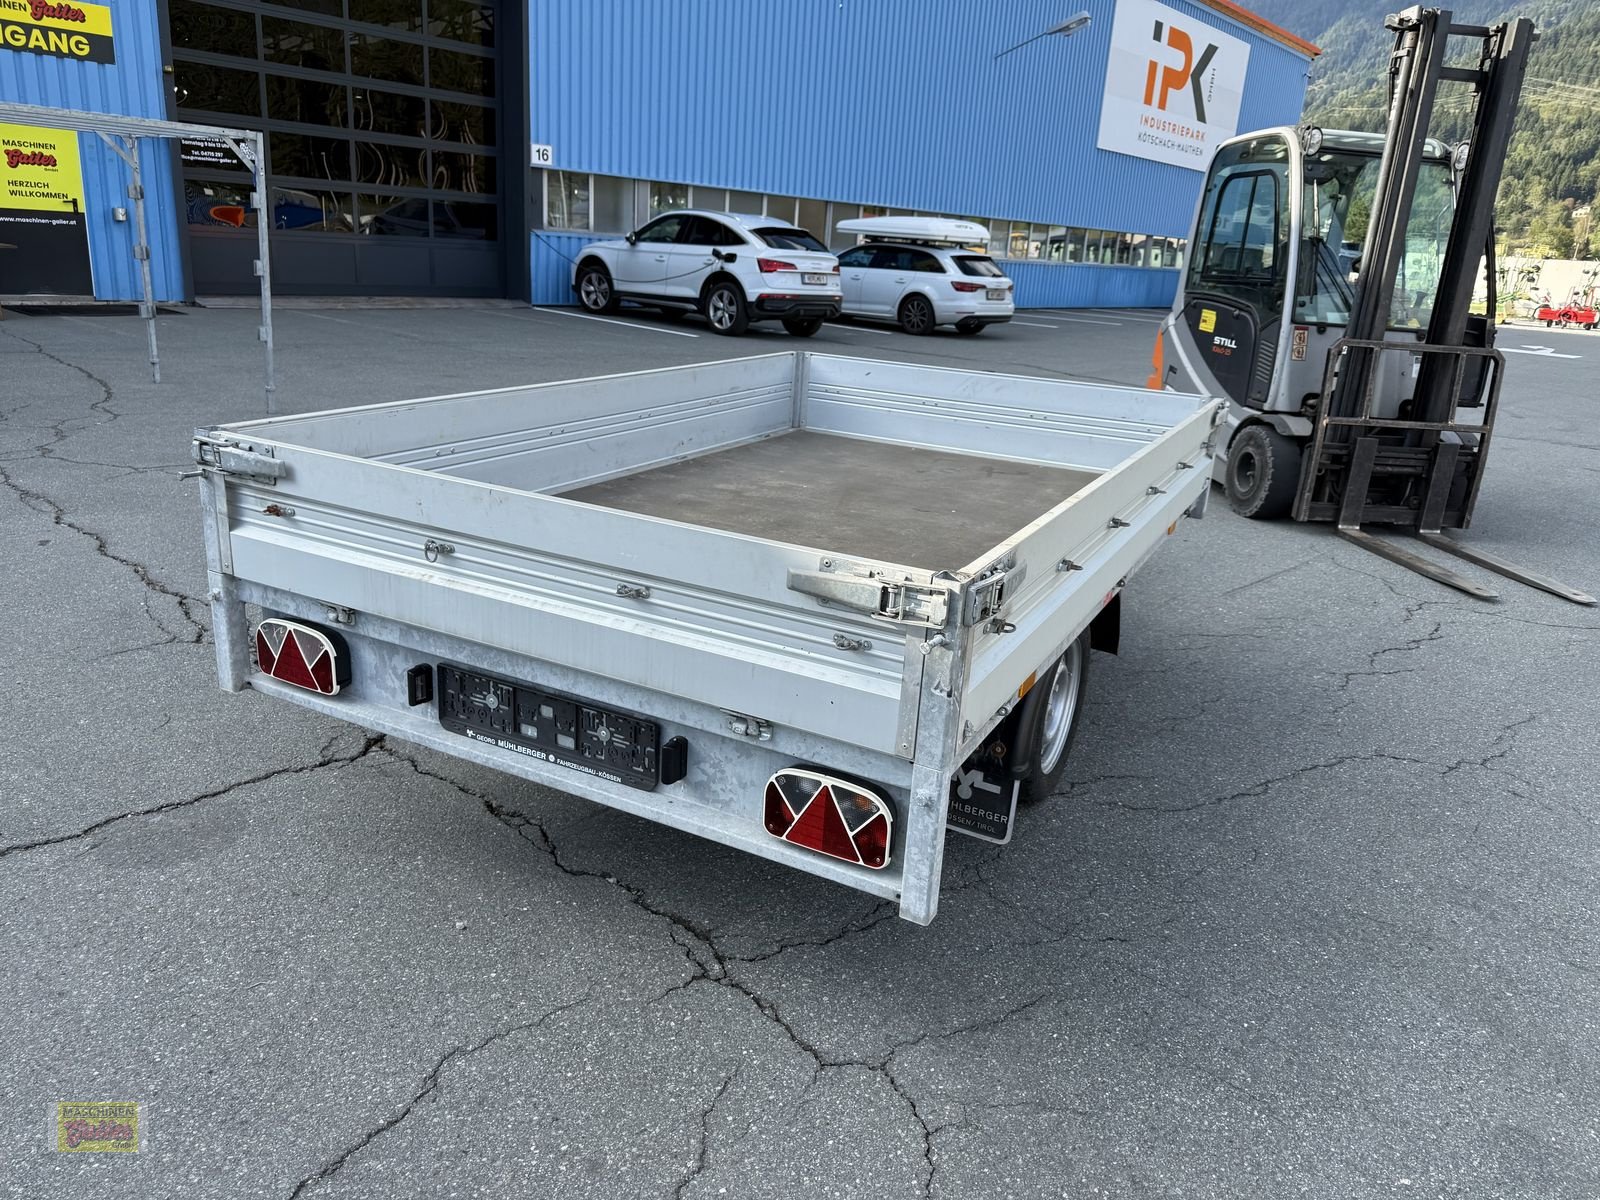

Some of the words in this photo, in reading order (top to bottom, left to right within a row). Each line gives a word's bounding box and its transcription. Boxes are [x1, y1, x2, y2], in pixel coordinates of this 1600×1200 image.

[0, 23, 91, 56] GANG
[1140, 113, 1207, 142] INDUSTRIEPARK
[2, 139, 56, 150] MASCHINEN
[4, 149, 58, 168] Gailer
[535, 148, 549, 161] 16
[8, 179, 49, 189] HERZLICH
[8, 189, 69, 200] WILLKOMMEN
[1213, 336, 1237, 349] STILL
[476, 734, 496, 745] GEORG
[497, 739, 547, 760] MÜHLBERGER
